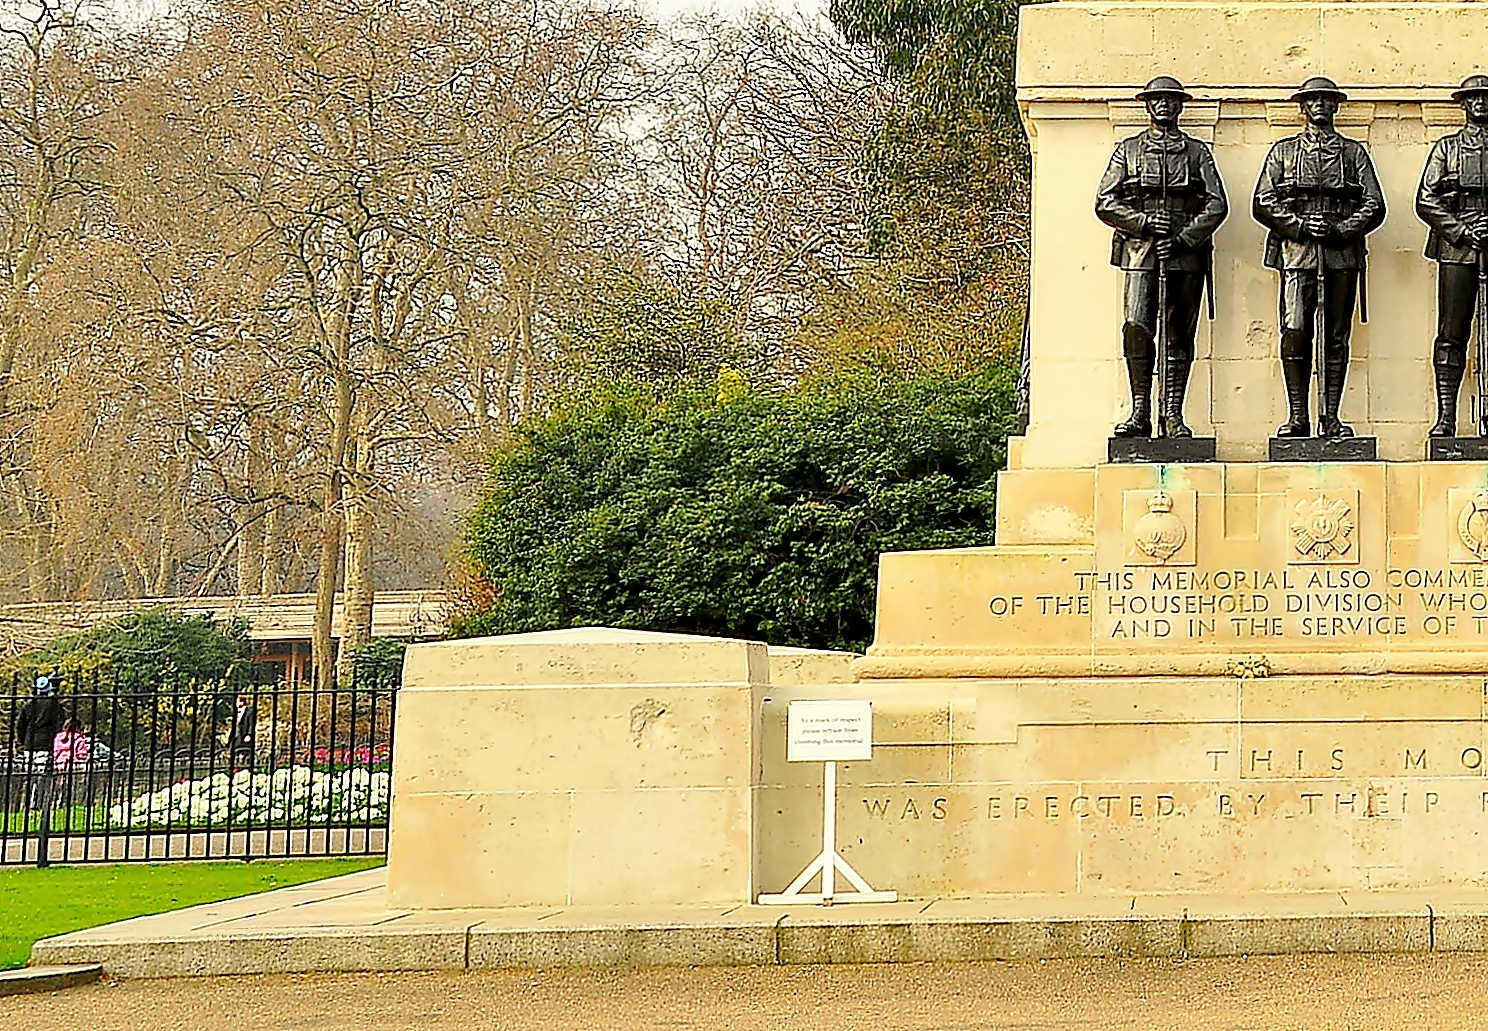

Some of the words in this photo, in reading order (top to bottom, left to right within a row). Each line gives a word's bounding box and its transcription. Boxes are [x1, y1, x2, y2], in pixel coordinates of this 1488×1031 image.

[1074, 572, 1134, 592] THIS
[1150, 570, 1295, 591] MEMORIAL
[1307, 570, 1371, 590] ALSO
[989, 597, 1022, 616] OF
[1036, 596, 1091, 615] THE
[1108, 594, 1269, 615] HOUSEHOLD
[1285, 593, 1402, 613] DIVISION
[1420, 592, 1488, 612] WHO
[1110, 617, 1171, 638] AND
[1188, 617, 1215, 638] IN
[1231, 617, 1283, 637] THE
[1301, 616, 1406, 636] SERVICE
[1422, 615, 1453, 635] OF
[1205, 748, 1345, 772] THIS
[862, 797, 948, 820] WAS
[986, 795, 1177, 820] ERECTED
[1217, 794, 1268, 819] BY
[1300, 792, 1441, 818] THEIR
